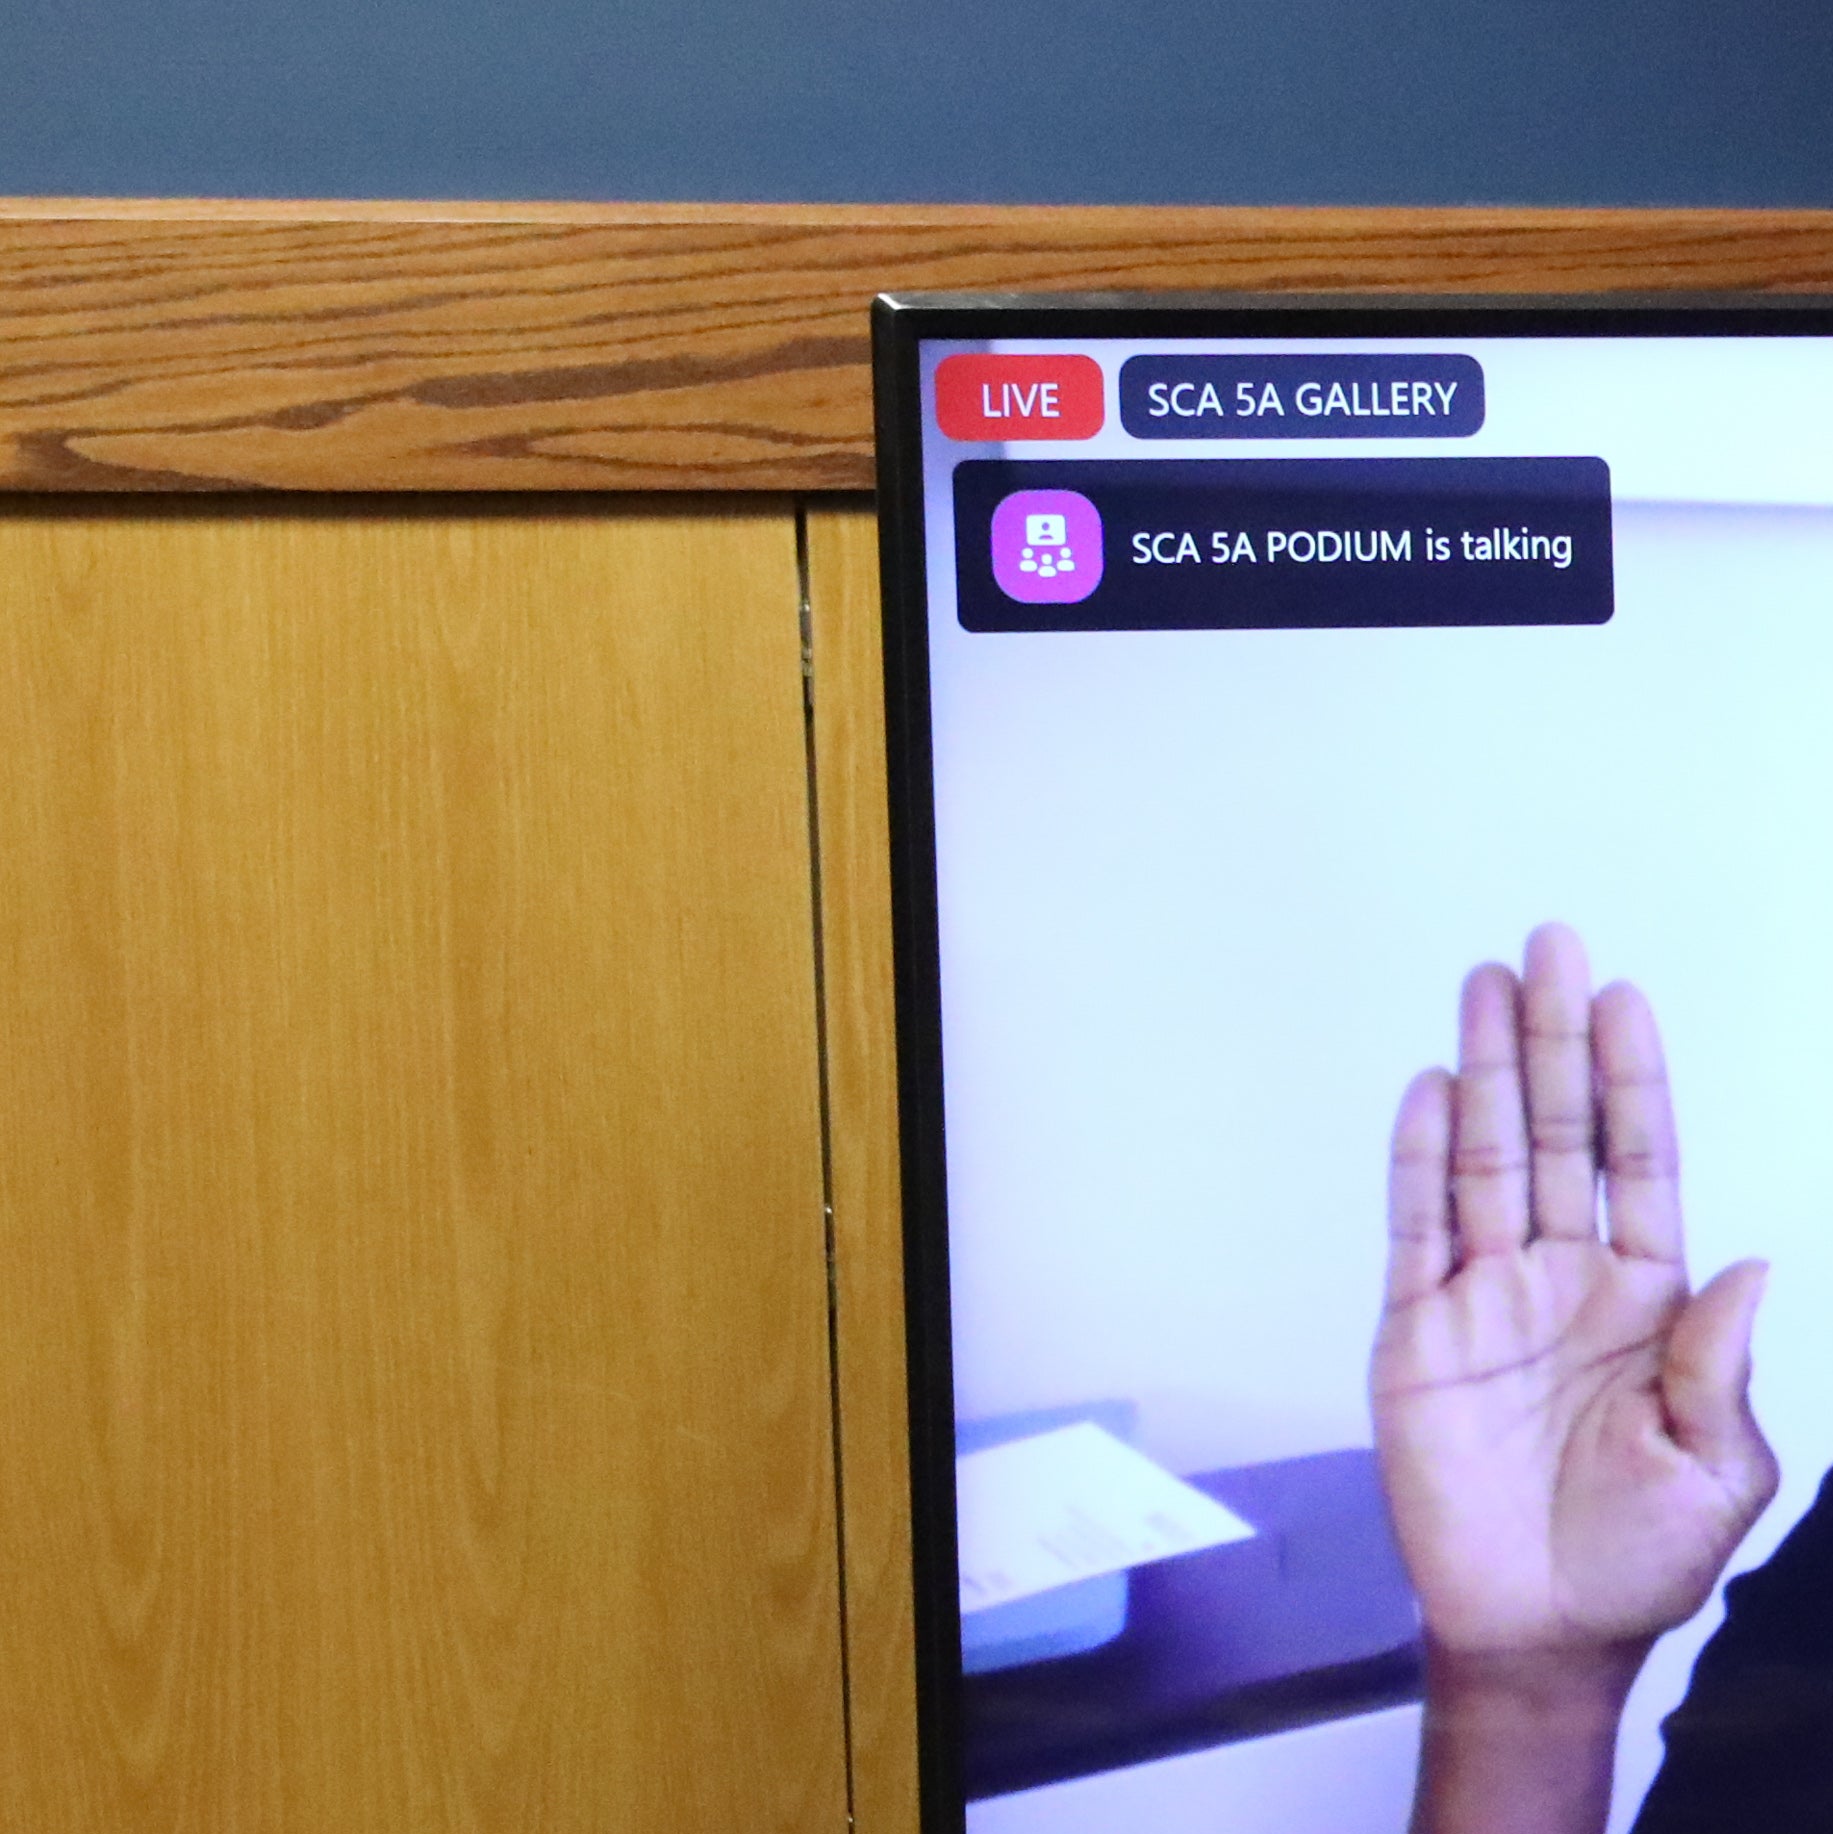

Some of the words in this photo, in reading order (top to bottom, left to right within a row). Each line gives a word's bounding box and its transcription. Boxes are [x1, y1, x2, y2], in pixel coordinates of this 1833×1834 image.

[981, 383, 1061, 419] LIVE
[1148, 383, 1223, 418] SCA
[1236, 383, 1284, 418] 5A
[1295, 381, 1458, 417] GALLERY
[1131, 532, 1201, 564] SCA
[1211, 532, 1257, 563] 5A
[1266, 530, 1412, 563] PODIUM
[1425, 528, 1451, 562] is
[1460, 526, 1574, 569] talking
